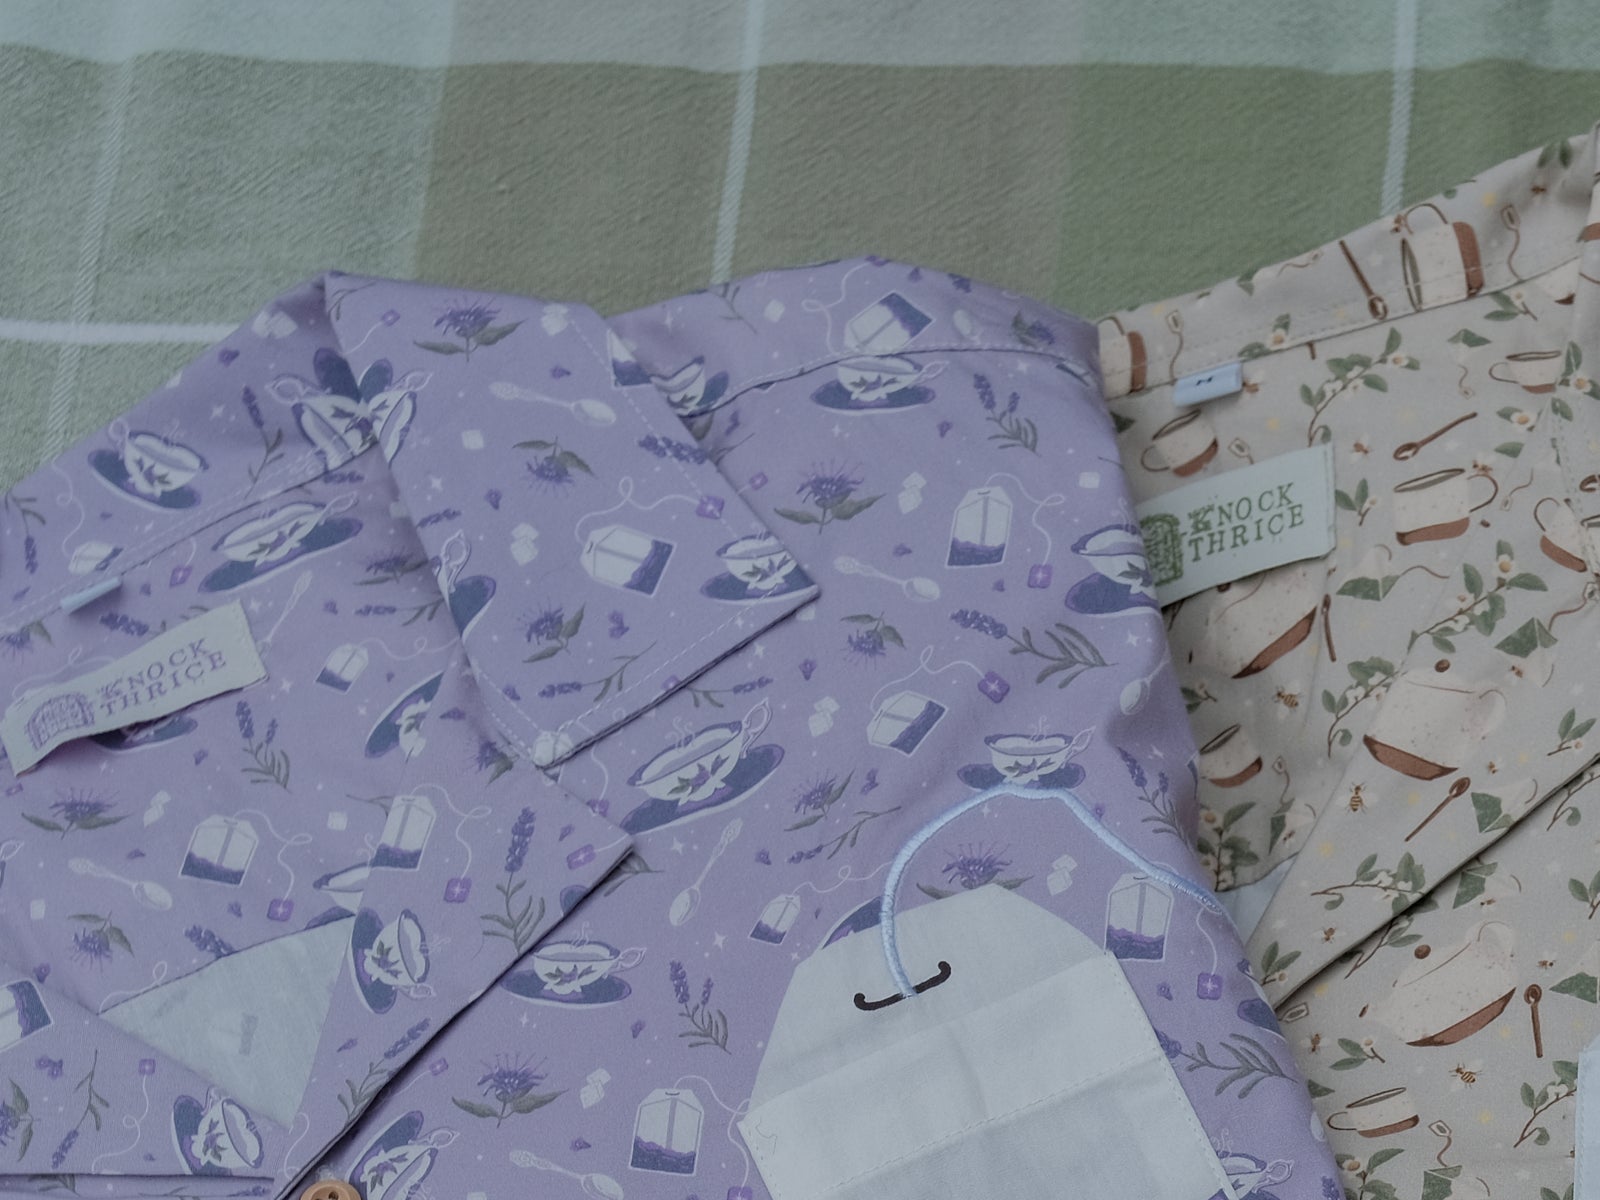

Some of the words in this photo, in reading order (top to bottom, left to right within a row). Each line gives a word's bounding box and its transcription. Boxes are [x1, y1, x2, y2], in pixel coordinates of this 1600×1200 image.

[1188, 482, 1294, 536] KNOCK
[1188, 503, 1304, 562] THRICE
[97, 638, 206, 698] KNOCK
[100, 650, 226, 716] THRICE
